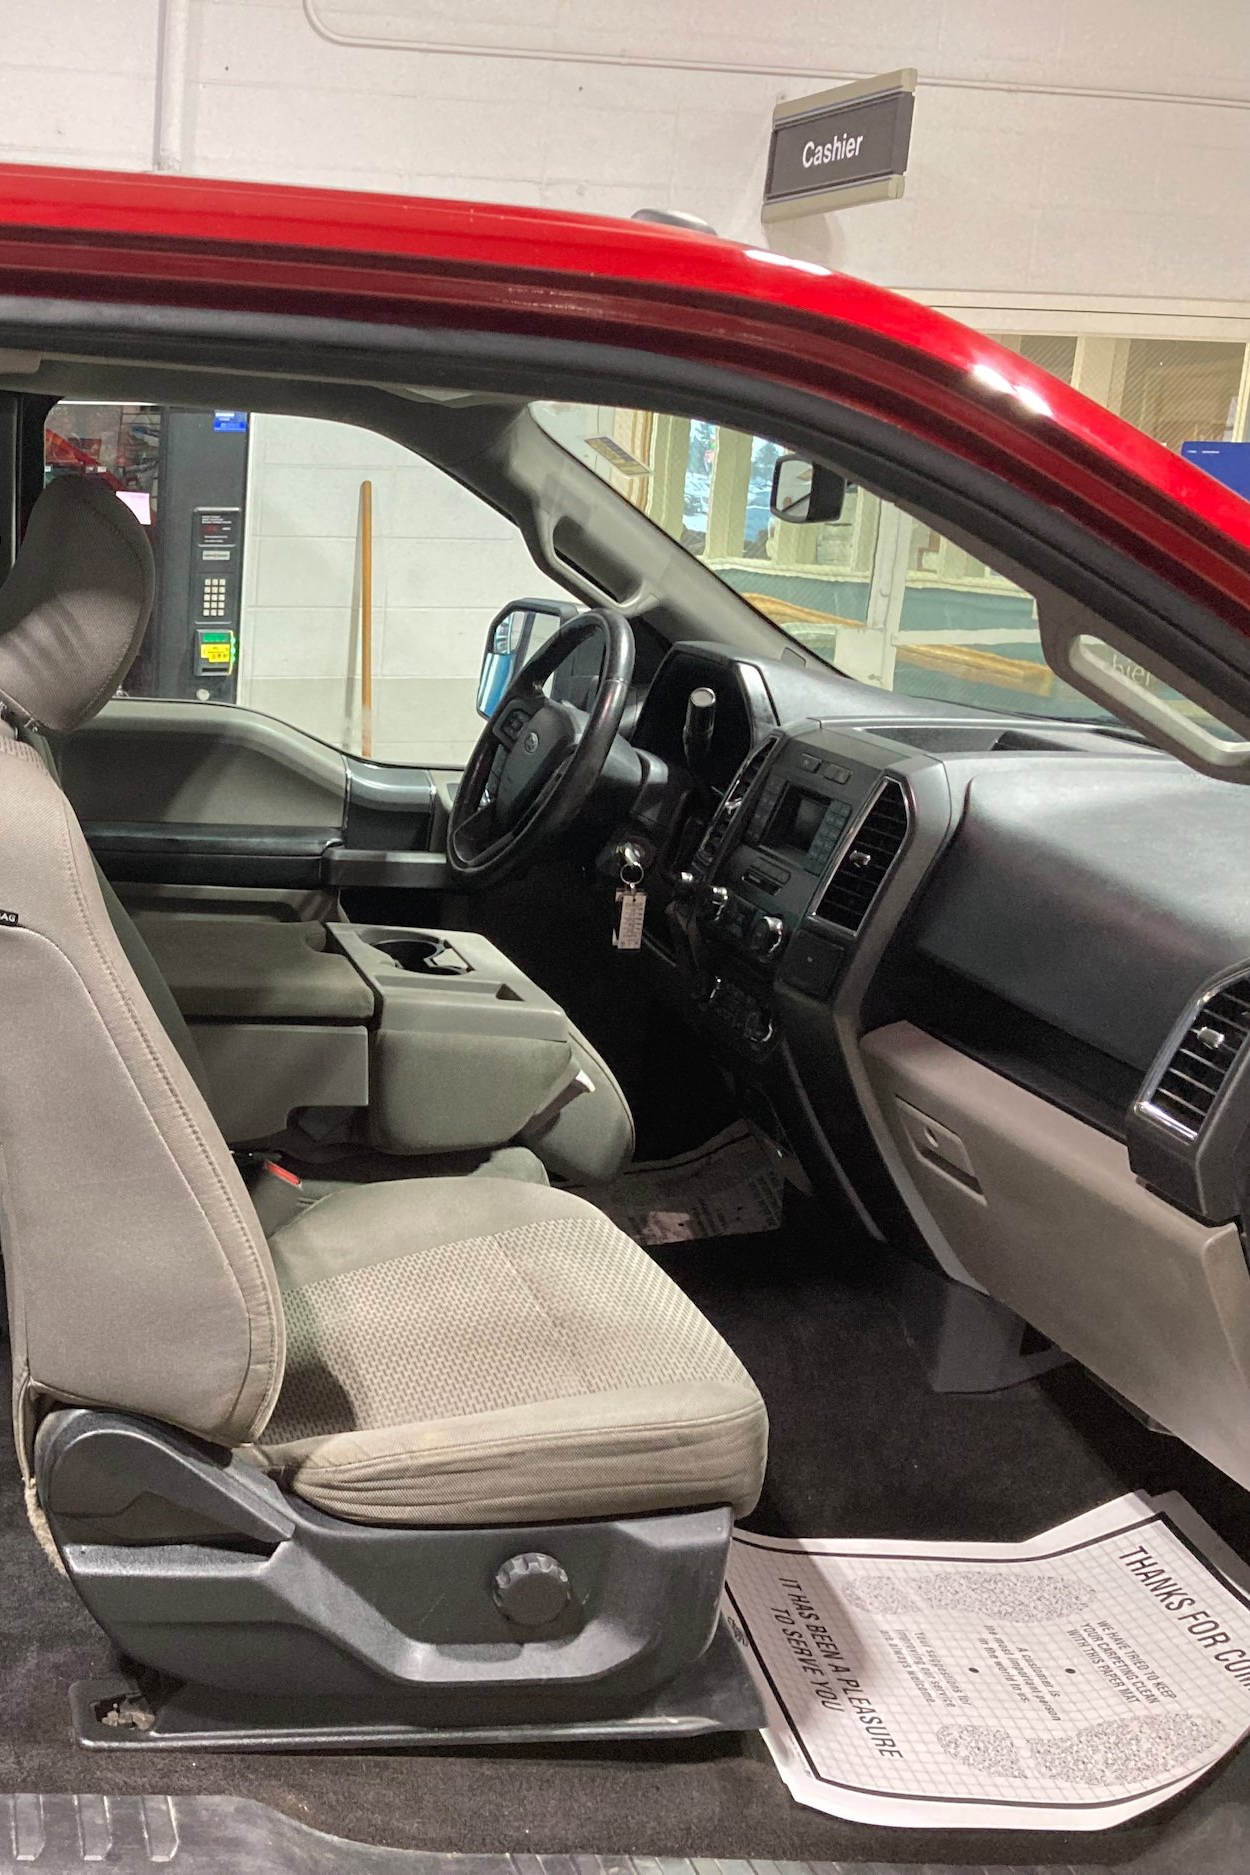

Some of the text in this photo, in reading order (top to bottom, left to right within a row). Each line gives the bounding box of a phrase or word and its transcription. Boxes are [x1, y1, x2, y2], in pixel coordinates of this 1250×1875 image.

[802, 133, 863, 168] Cashier
[1118, 1545, 1196, 1611] THANKS
[1177, 1610, 1231, 1649] FOR
[770, 1607, 845, 1713] TO SERVE YOU
[779, 1577, 904, 1759] IT HAS BEEN A PLEASURE
[880, 1630, 894, 1641] are
[888, 1642, 912, 1669] always
[914, 1631, 972, 1706] Your suggestions for
[920, 1667, 936, 1679] our
[930, 1680, 956, 1707] service
[984, 1647, 999, 1659] the
[994, 1661, 1018, 1682] world
[1010, 1683, 1022, 1691] to
[984, 1624, 1061, 1721] the most important person
[1022, 1654, 1054, 1688] customer
[1049, 1690, 1061, 1698] is
[1066, 1628, 1141, 1704] WITH THIS PAPER MAT
[1080, 1623, 1162, 1704] YOUR CARPETING CLEAN
[1097, 1620, 1177, 1699] WE HAVE TRIED TO KEEP
